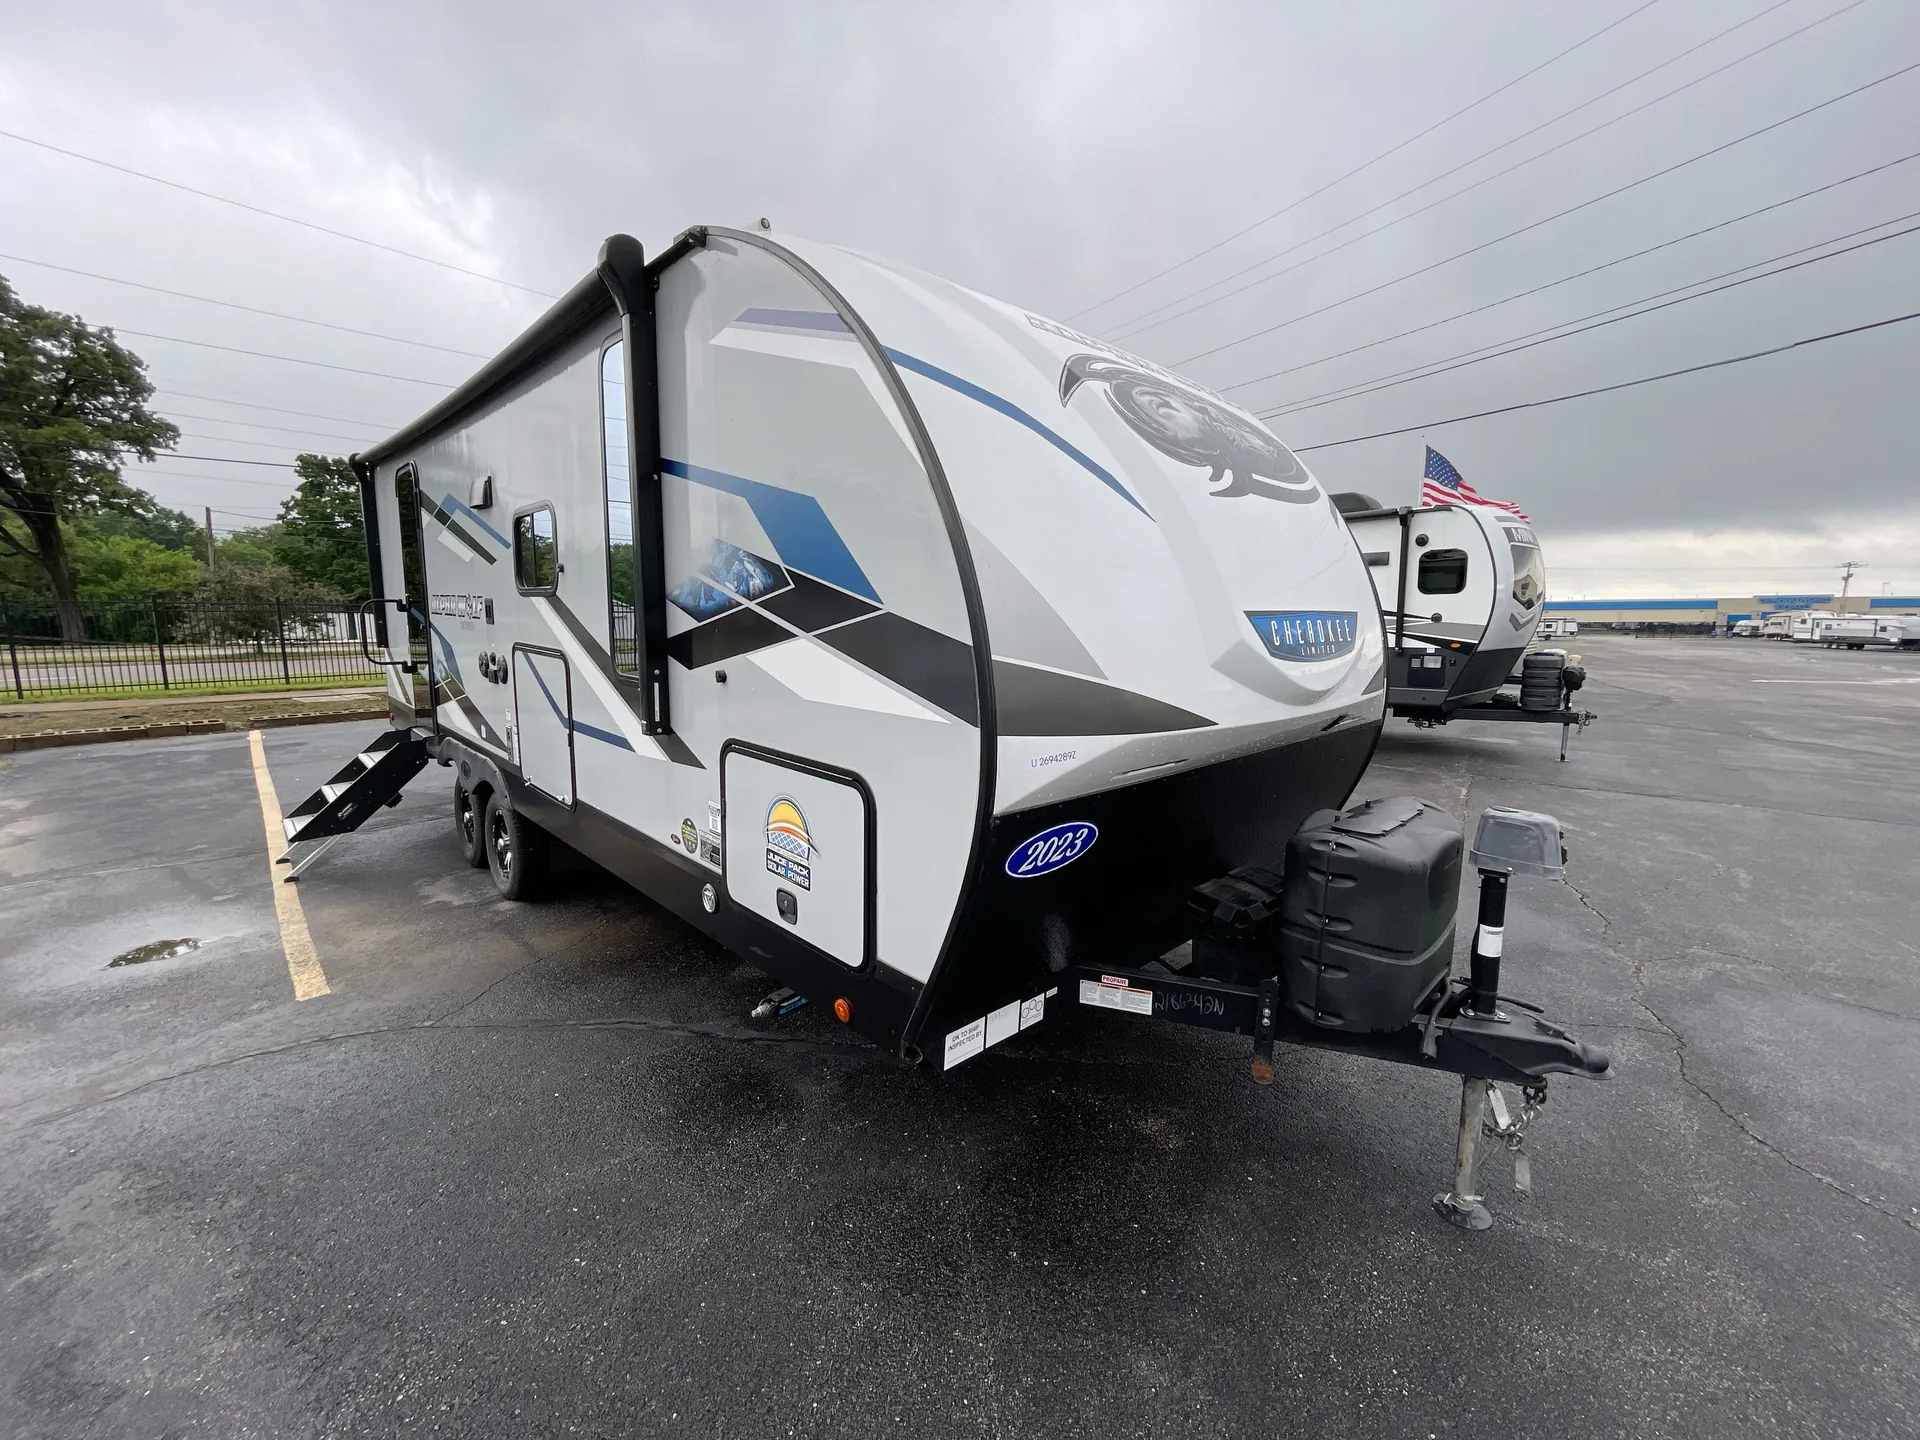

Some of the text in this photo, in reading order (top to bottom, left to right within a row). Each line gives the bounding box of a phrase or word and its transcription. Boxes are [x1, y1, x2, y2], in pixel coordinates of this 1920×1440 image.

[1271, 619, 1352, 646] CHEROKEE
[1301, 645, 1336, 656] LIMITED
[1031, 759, 1038, 768] U
[1017, 828, 1088, 873] 2023
[768, 851, 787, 866] JUICE
[789, 862, 809, 878] PACK
[768, 860, 809, 888] SOLAR POWER
[1102, 976, 1127, 985] PROPANE
[948, 1030, 982, 1052] INSPECTED BY
[952, 1024, 979, 1043] OK TO SHIP
